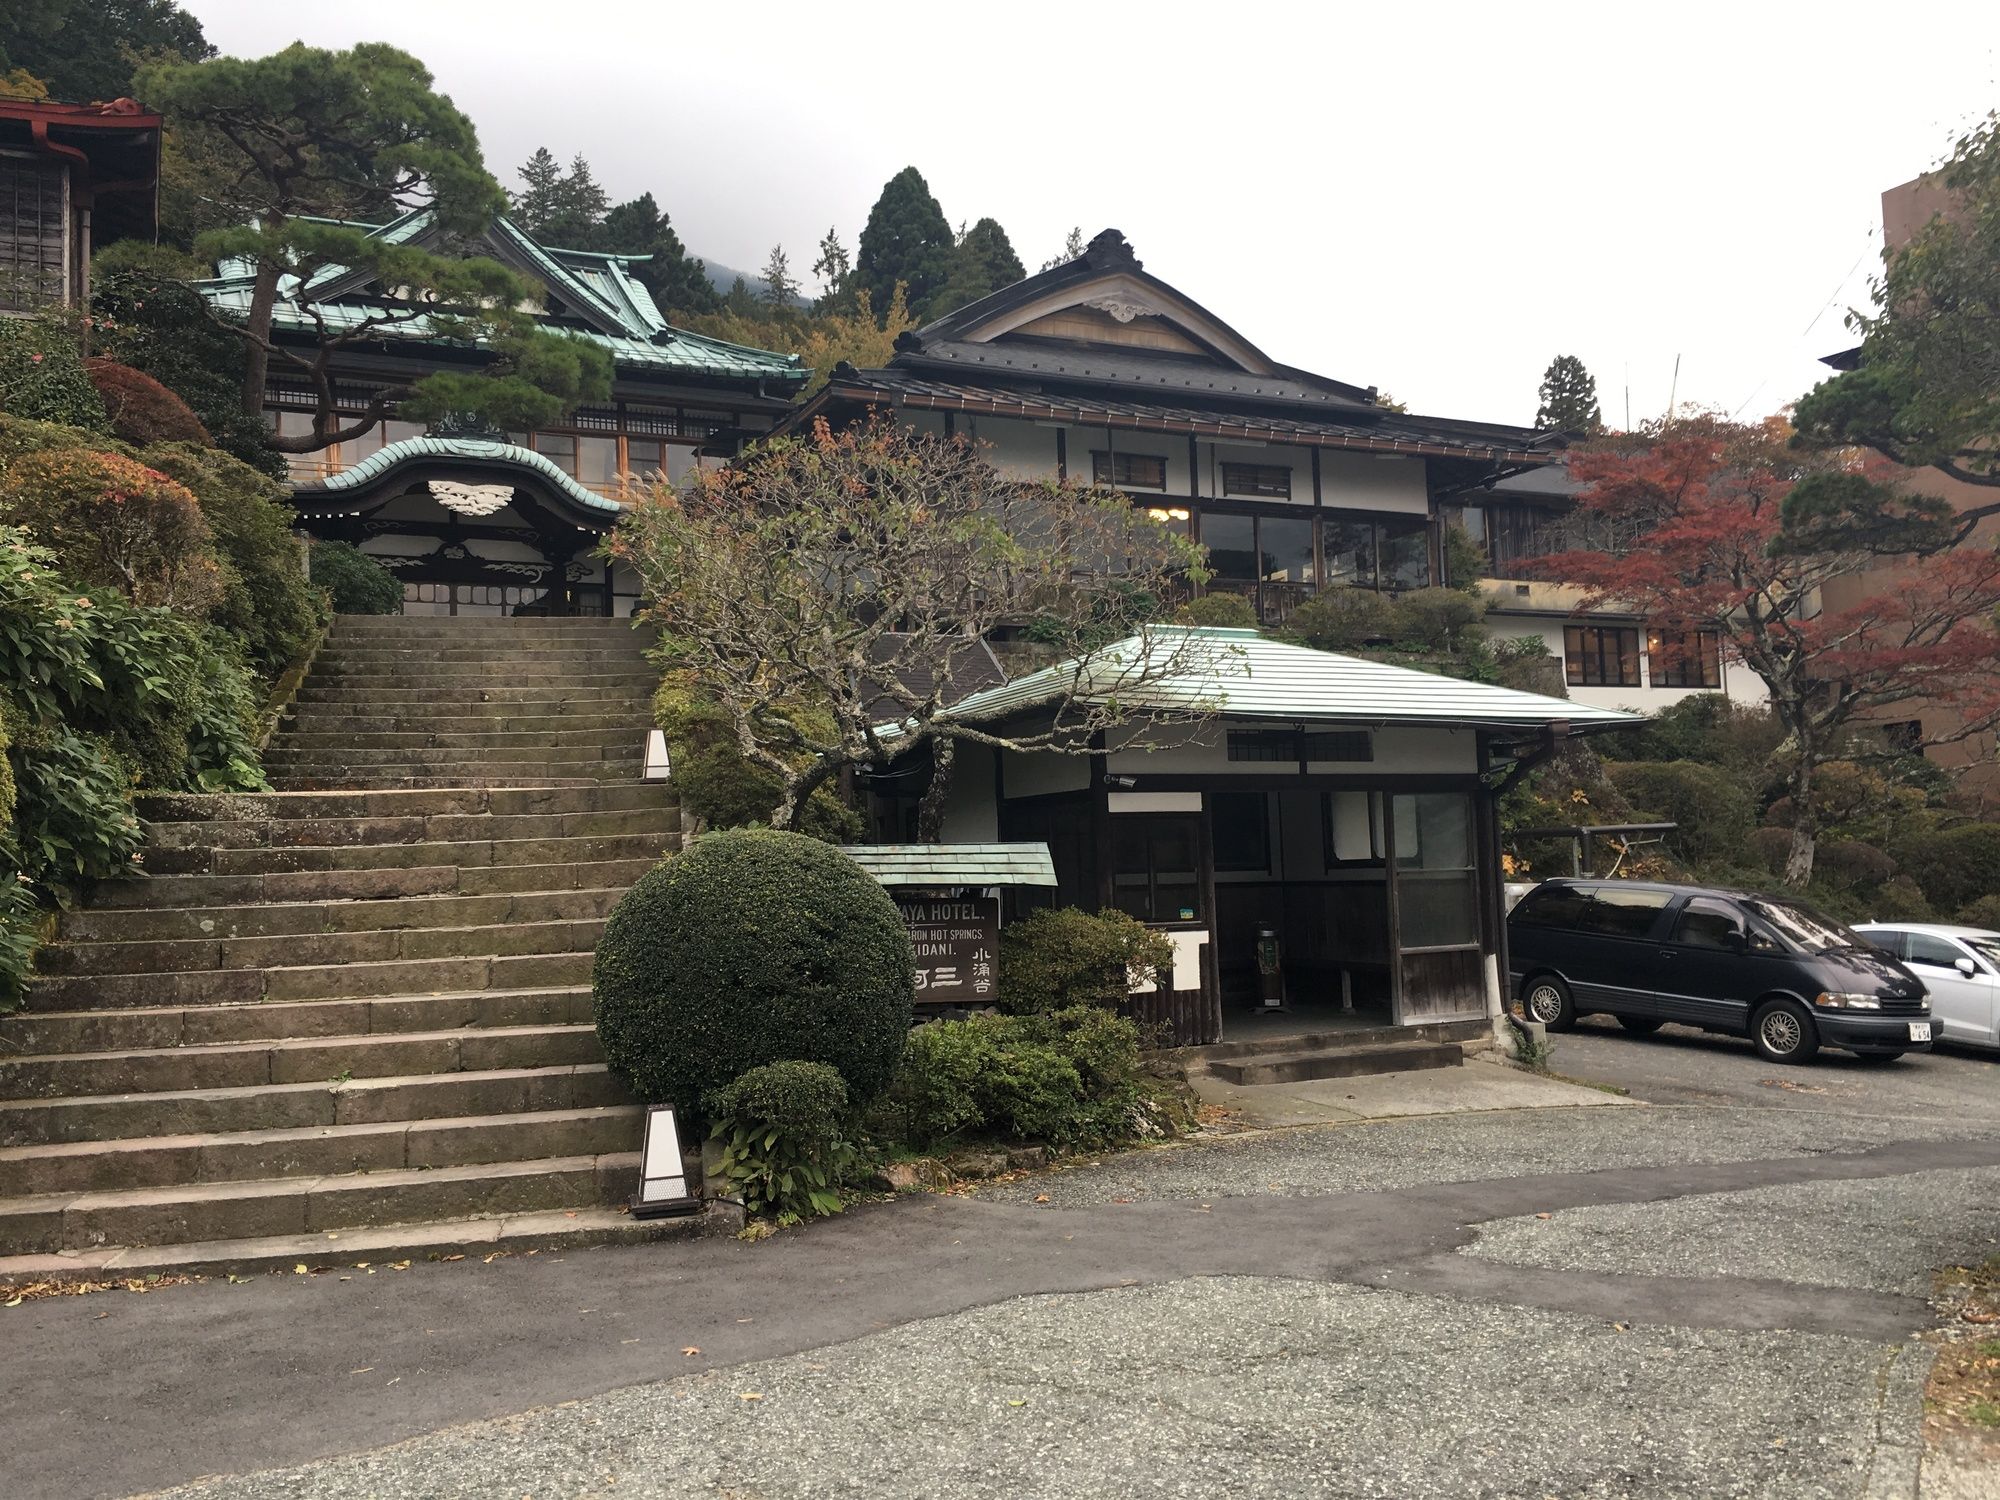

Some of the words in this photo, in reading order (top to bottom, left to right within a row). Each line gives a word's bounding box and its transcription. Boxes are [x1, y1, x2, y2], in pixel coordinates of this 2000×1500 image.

[898, 904, 926, 921] AYA
[930, 929, 948, 941] HOT
[912, 943, 957, 956] IDANI.
